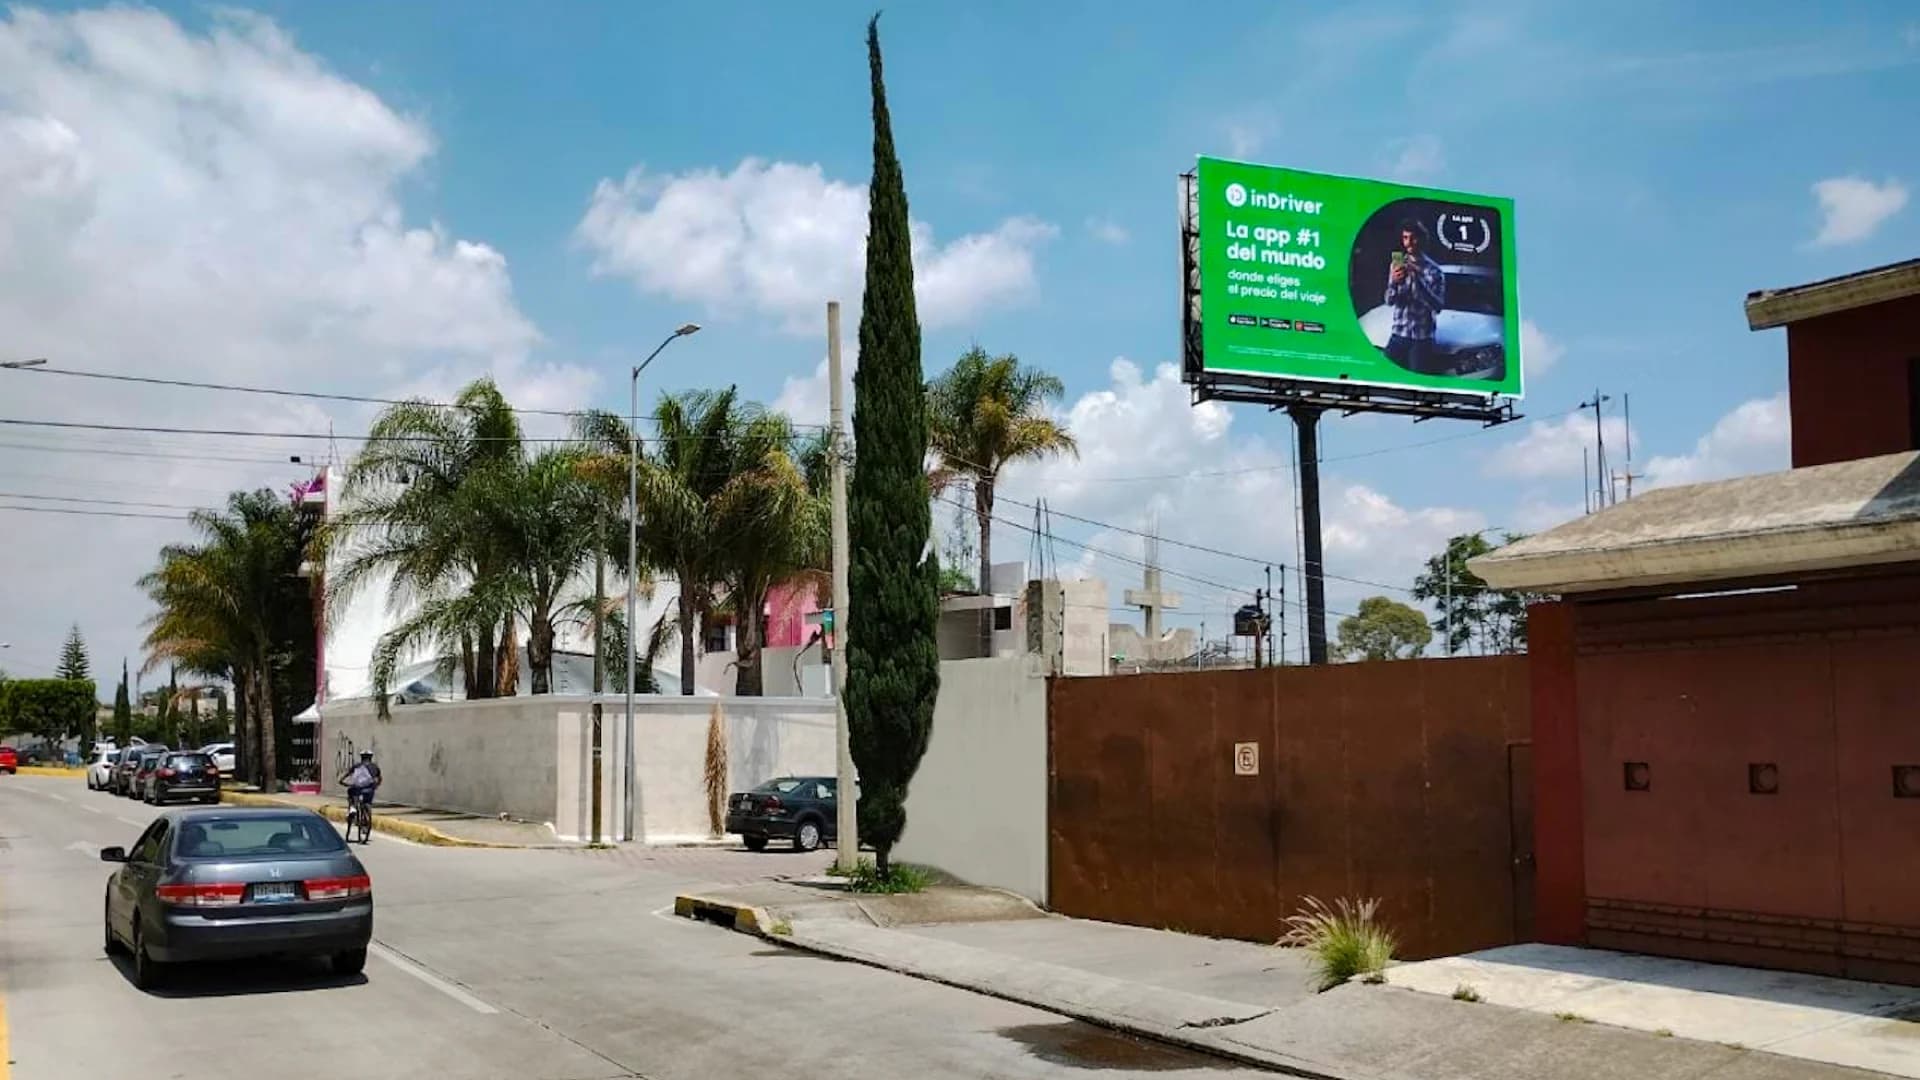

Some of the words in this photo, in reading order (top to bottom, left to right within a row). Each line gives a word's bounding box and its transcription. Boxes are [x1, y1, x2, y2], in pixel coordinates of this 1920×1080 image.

[1251, 188, 1323, 215] inDriver
[1226, 220, 1249, 238] La
[1253, 226, 1291, 248] app
[1296, 228, 1320, 247] #1
[1459, 225, 1468, 241] 1
[1226, 242, 1256, 261] del
[1261, 250, 1325, 270] mundo
[1227, 269, 1264, 283] donde
[1266, 273, 1300, 288] eliges
[1227, 283, 1238, 294] el
[1240, 286, 1277, 298] precio
[1280, 289, 1297, 300] del
[1300, 291, 1326, 306] viaje
